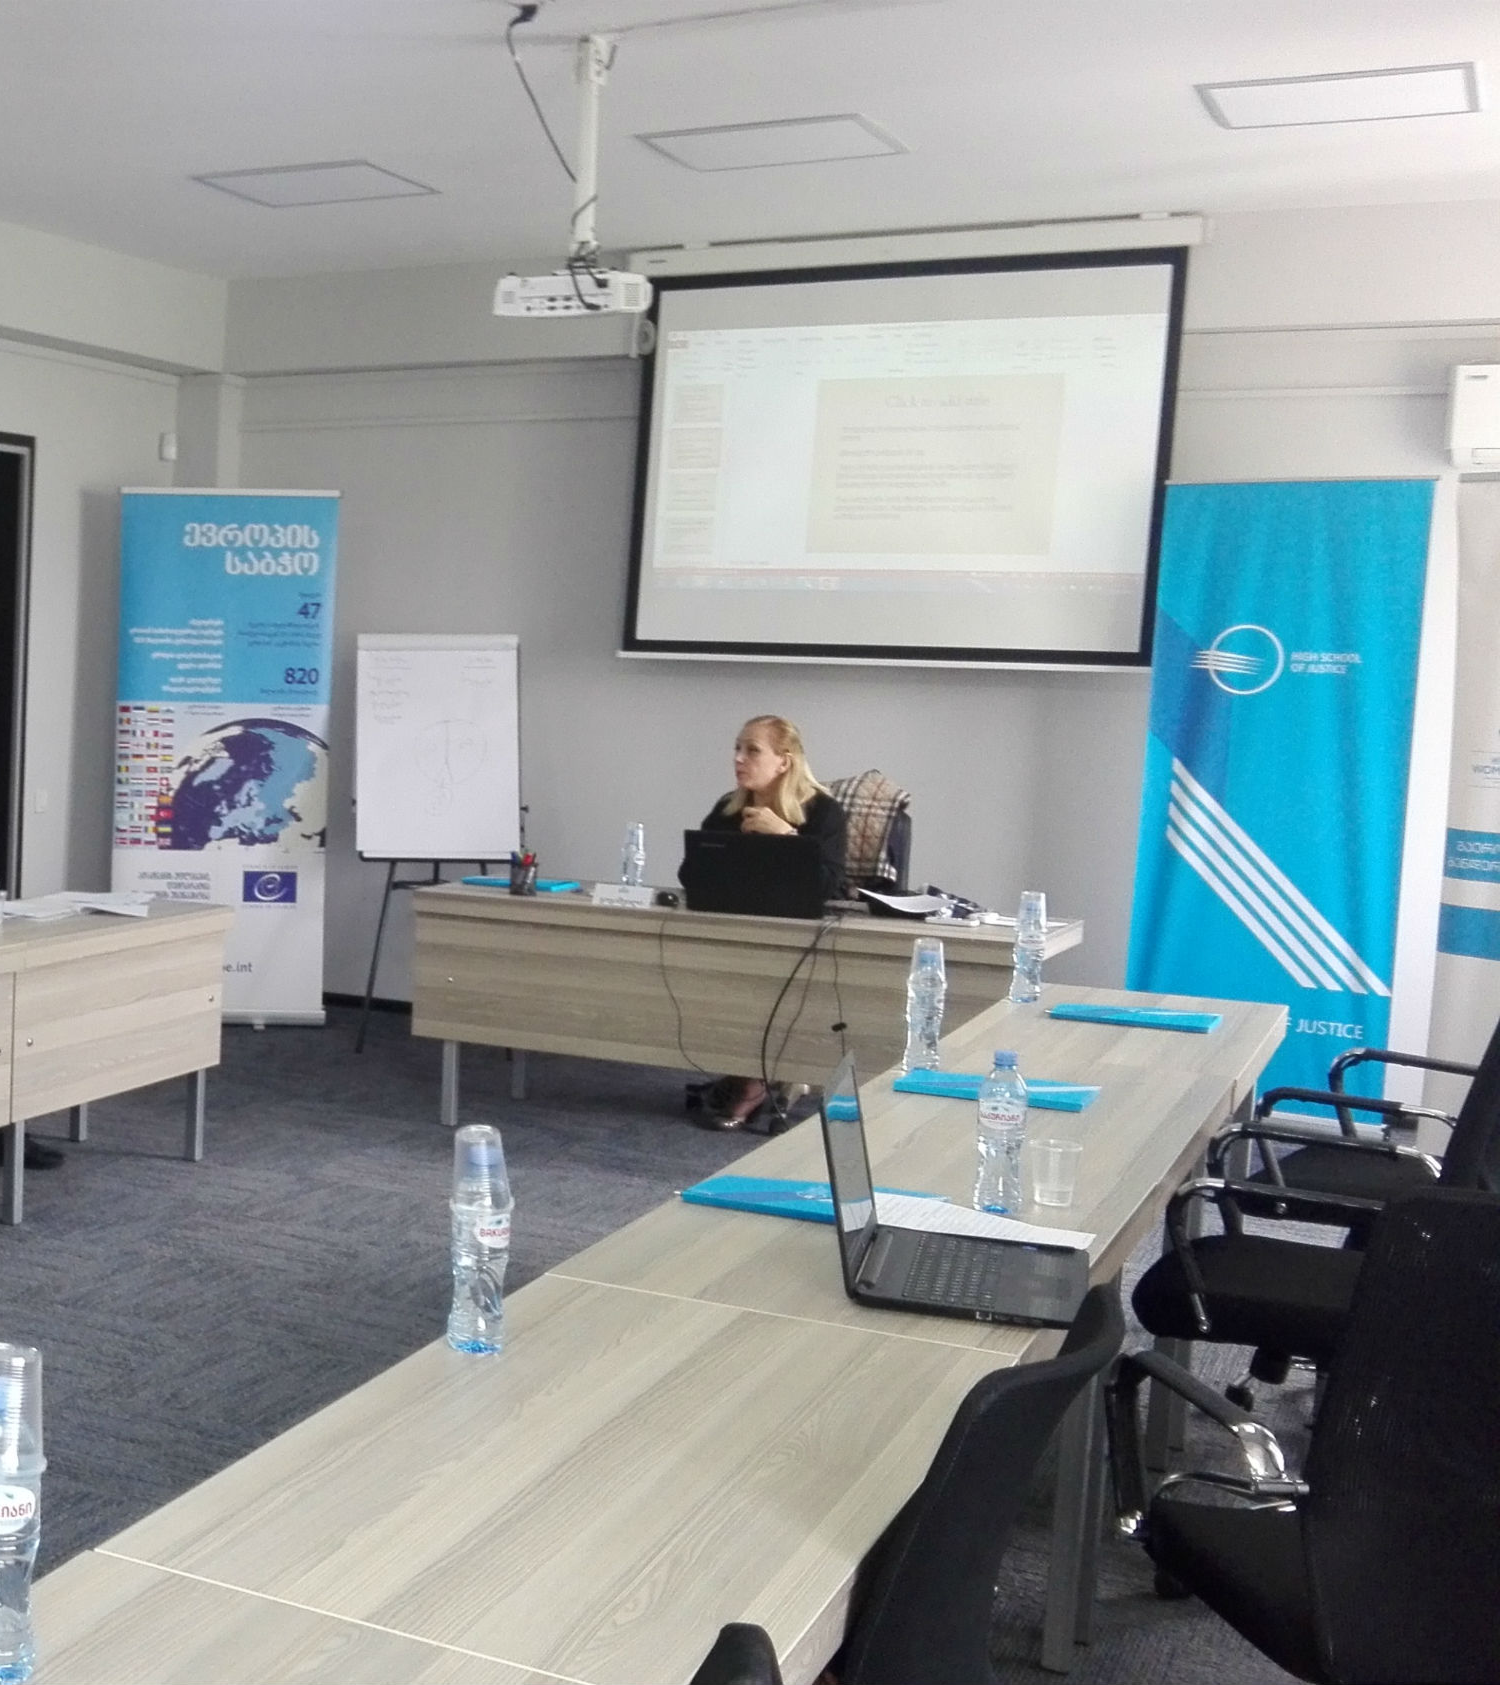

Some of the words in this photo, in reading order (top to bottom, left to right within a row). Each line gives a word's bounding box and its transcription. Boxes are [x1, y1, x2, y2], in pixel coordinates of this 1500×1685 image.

[183, 523, 320, 548] ევროპის
[225, 551, 320, 575] საბჭო
[297, 602, 321, 619] 47
[284, 667, 319, 684] 820
[1295, 1019, 1363, 1039] JUSTICE
